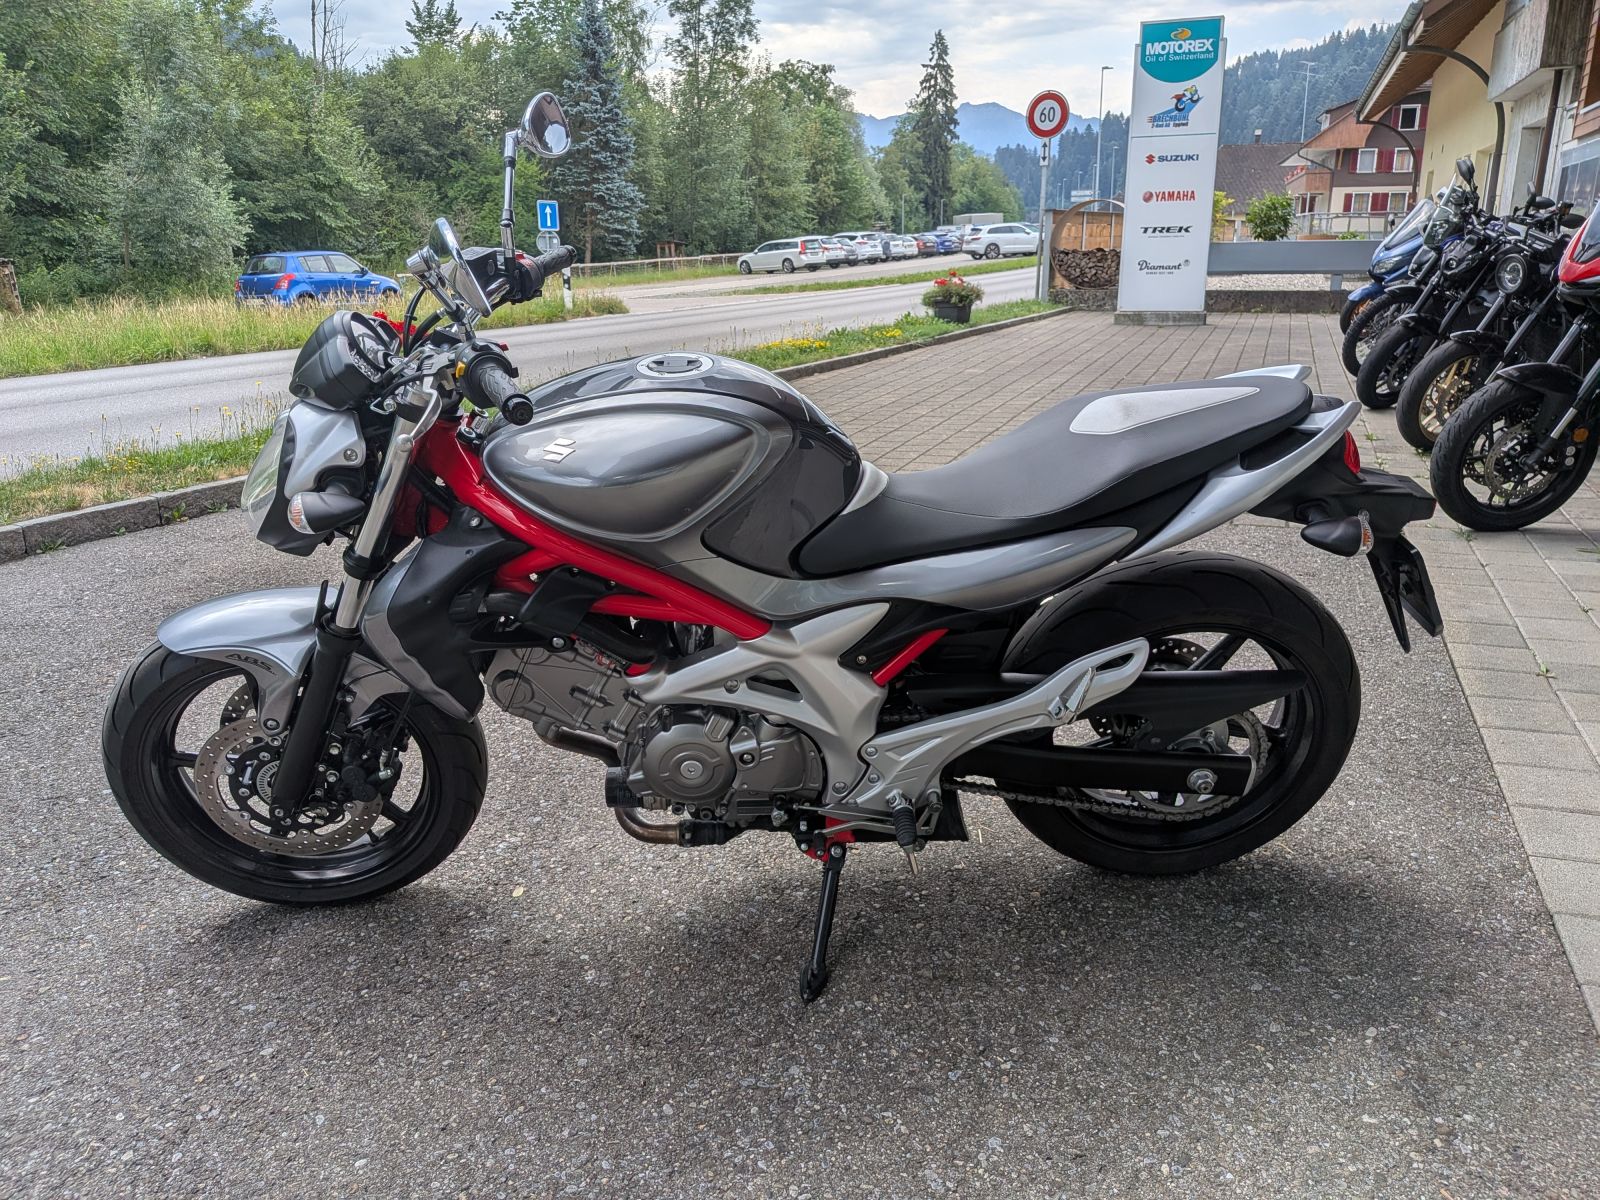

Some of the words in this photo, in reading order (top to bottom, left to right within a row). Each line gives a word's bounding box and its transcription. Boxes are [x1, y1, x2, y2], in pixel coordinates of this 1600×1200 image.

[1145, 39, 1214, 55] MOTOREX
[1168, 52, 1214, 61] Switzerland
[1039, 106, 1056, 124] 60
[1157, 154, 1199, 162] SUZUKI
[1154, 190, 1196, 202] YAMAHA
[1140, 225, 1193, 234] TREK
[1137, 259, 1182, 271] Diamant
